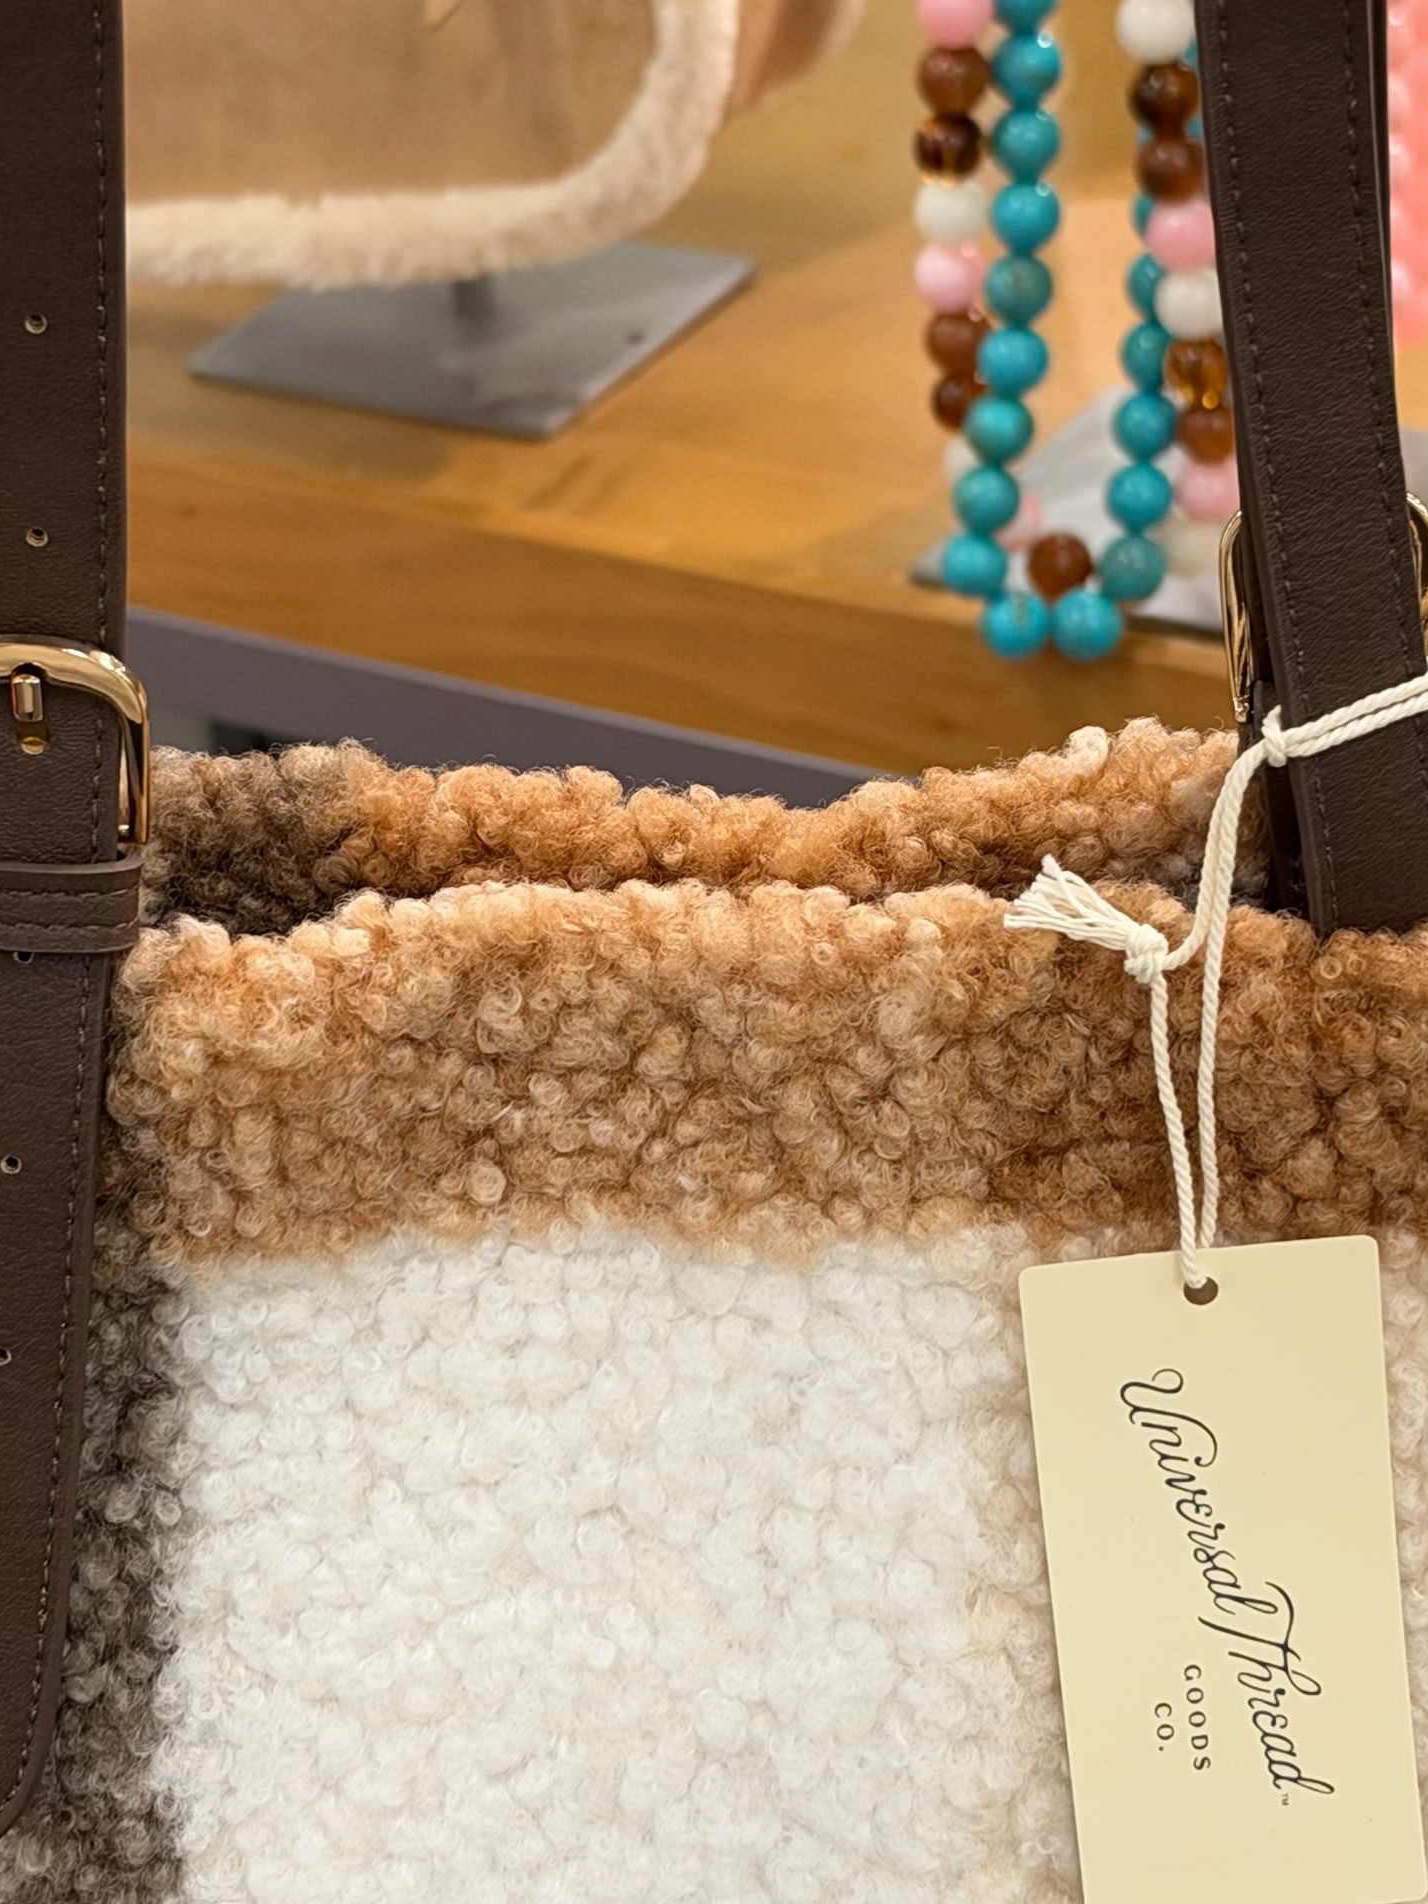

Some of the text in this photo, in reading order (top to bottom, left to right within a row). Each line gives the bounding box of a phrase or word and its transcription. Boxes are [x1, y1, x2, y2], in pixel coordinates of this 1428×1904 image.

[1119, 1367, 1278, 1616] Universal
[1153, 1701, 1175, 1753] CO.
[1183, 1663, 1212, 1771] GOODS
[1198, 1580, 1335, 1795] Thread
